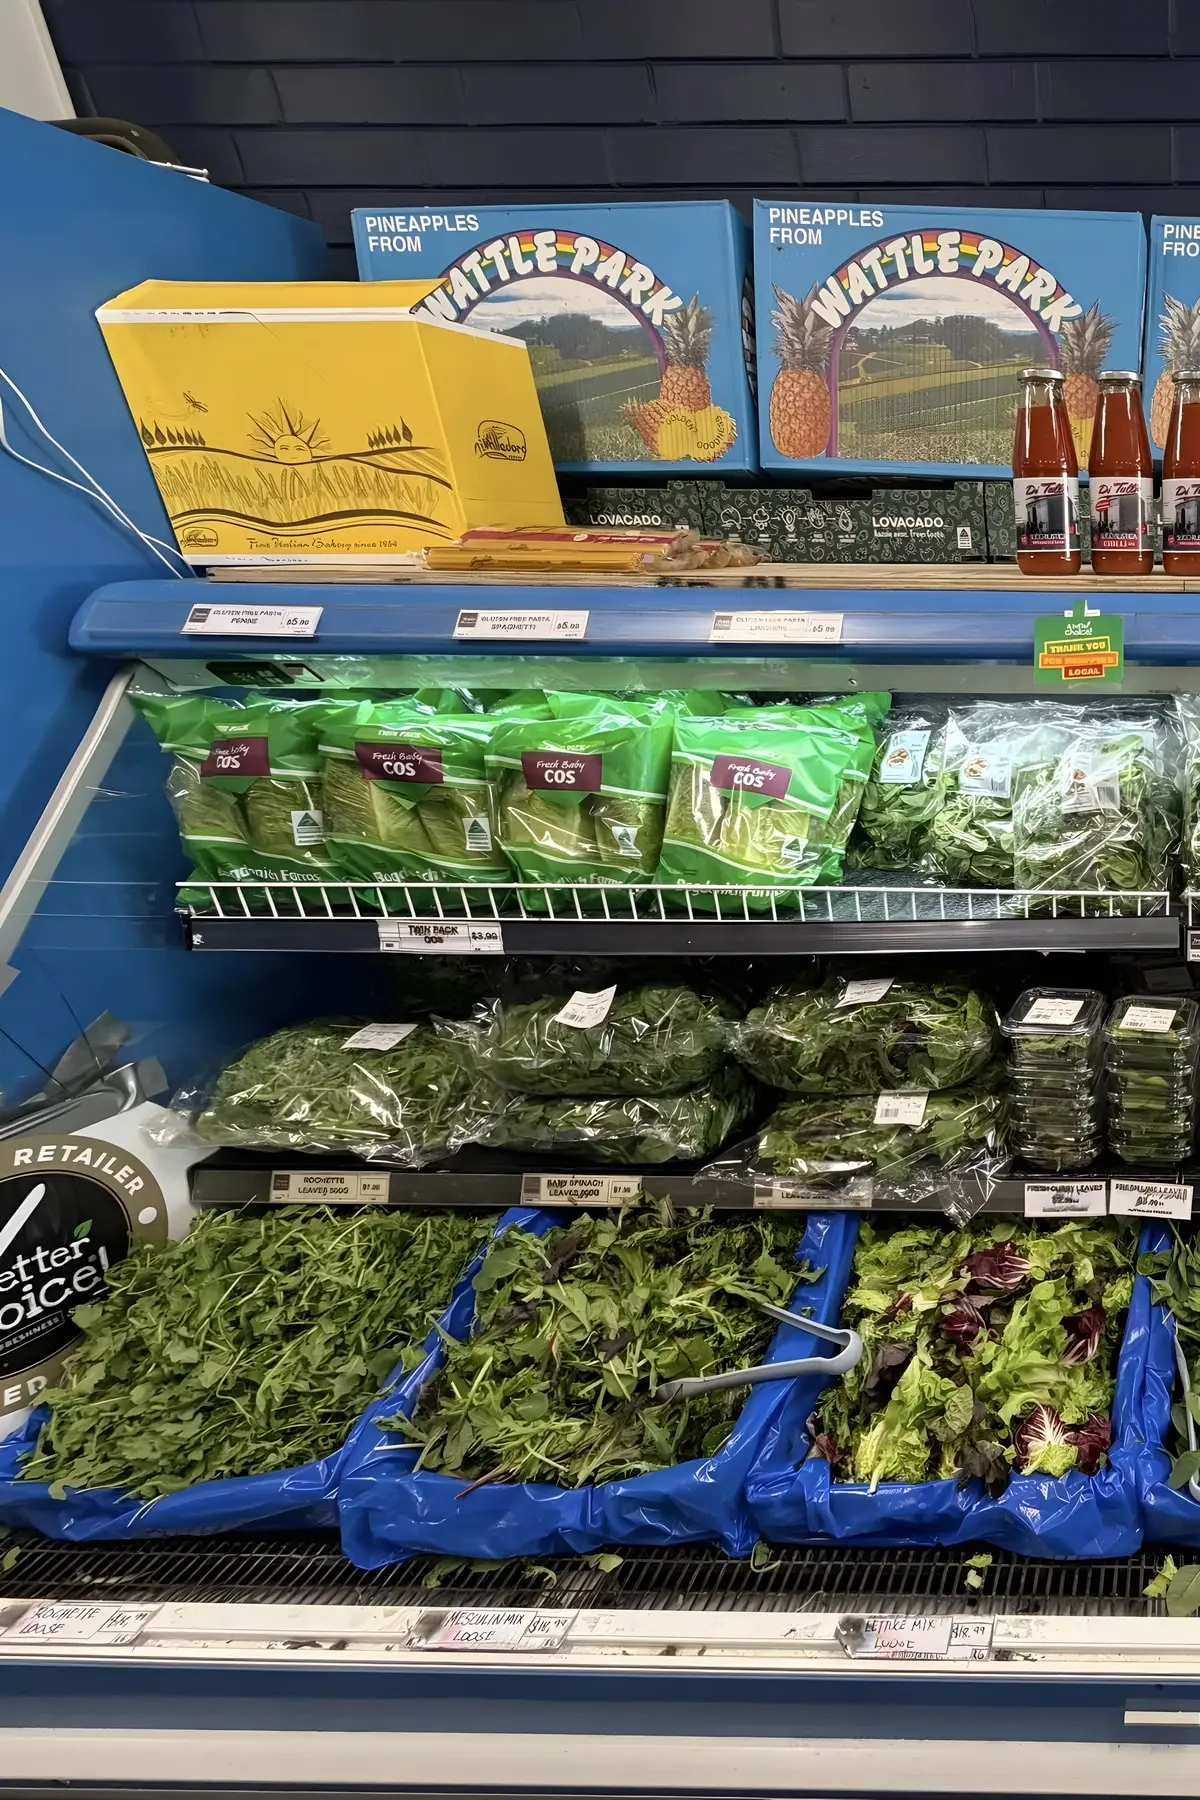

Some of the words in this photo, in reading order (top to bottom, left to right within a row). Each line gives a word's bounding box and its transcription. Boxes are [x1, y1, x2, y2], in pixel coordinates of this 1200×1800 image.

[366, 214, 479, 233] PINEAPPLES
[769, 208, 884, 228] PINEAPPLES
[770, 228, 822, 245] FROM
[368, 235, 422, 253] FROM
[419, 230, 559, 323] WATTLE
[570, 236, 683, 326] PARK
[810, 231, 961, 329] WATTLE
[972, 238, 1083, 332] PARK
[590, 514, 661, 527] LOVACADO
[872, 517, 944, 528] LOVACADO
[1050, 644, 1084, 653] THANK
[1086, 642, 1106, 650] YOU
[1068, 668, 1100, 676] LOCAL
[216, 755, 241, 768] COS
[536, 760, 559, 768] Fresh
[561, 760, 586, 772] Baby
[383, 762, 416, 776] COS
[544, 769, 575, 784] COS
[734, 771, 764, 788] COS
[13, 1145, 144, 1196] RETAILER
[19, 1623, 65, 1635] LOOSE
[911, 1618, 936, 1631] MIX
[453, 1630, 495, 1641] LOOSE
[875, 1637, 915, 1649] LOOSE
